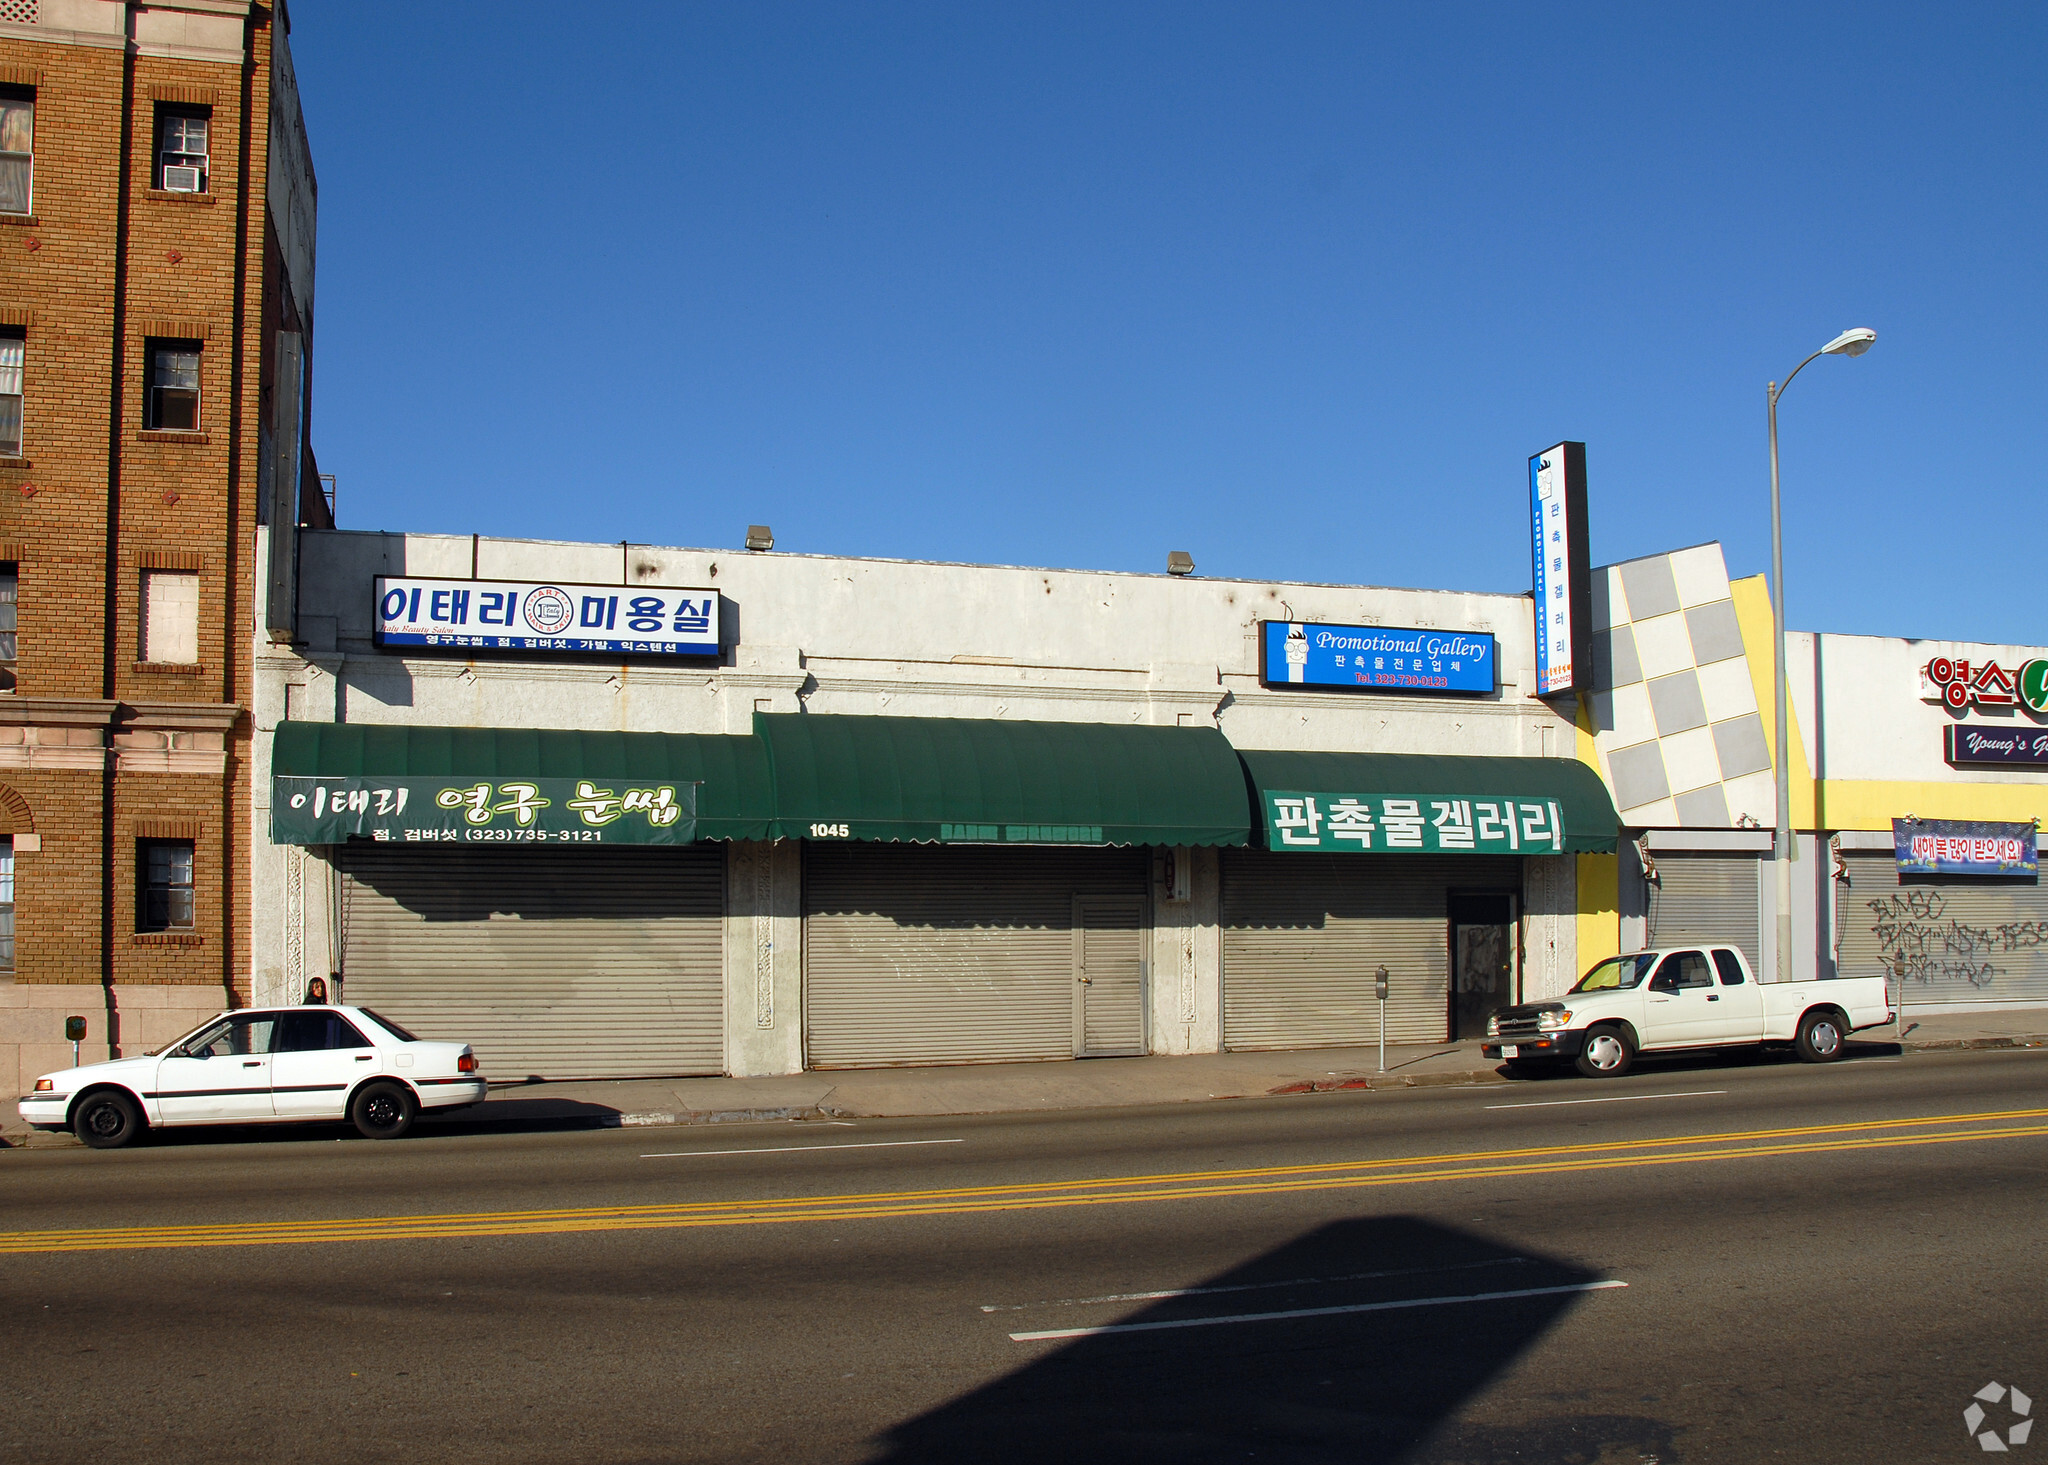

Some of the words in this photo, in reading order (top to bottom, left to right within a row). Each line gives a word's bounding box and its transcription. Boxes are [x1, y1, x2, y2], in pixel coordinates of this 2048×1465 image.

[1535, 511, 1544, 592] PROMOTIONAL
[538, 589, 560, 597] ART
[380, 587, 518, 626] 이태리
[580, 595, 712, 634] 미용실
[527, 612, 544, 631] HAIR
[554, 613, 571, 631] SKIN
[401, 624, 430, 635] Beauty
[431, 626, 454, 634] Salon
[1538, 606, 1546, 660] GALLERY
[620, 641, 677, 653] 익스텐션
[1315, 631, 1425, 654] Promotional
[1426, 636, 1486, 662] Gallery
[1355, 672, 1373, 684] Tel.
[1374, 673, 1447, 687] 323-730-0123
[1929, 656, 2014, 708] 영스
[1966, 732, 2028, 755] Young's
[290, 786, 409, 819] 이태리
[436, 782, 551, 827] 영구
[810, 823, 849, 838] 1045
[1273, 796, 1562, 850] 판촉물겔러리
[373, 828, 397, 841] 점.
[404, 828, 458, 841] 검버섯
[465, 828, 602, 842] (323)735-3121
[1912, 837, 1935, 859] 새해
[1936, 838, 1947, 860] 복
[1949, 838, 1971, 860] 많이
[1974, 839, 2020, 861] 받으세요!
